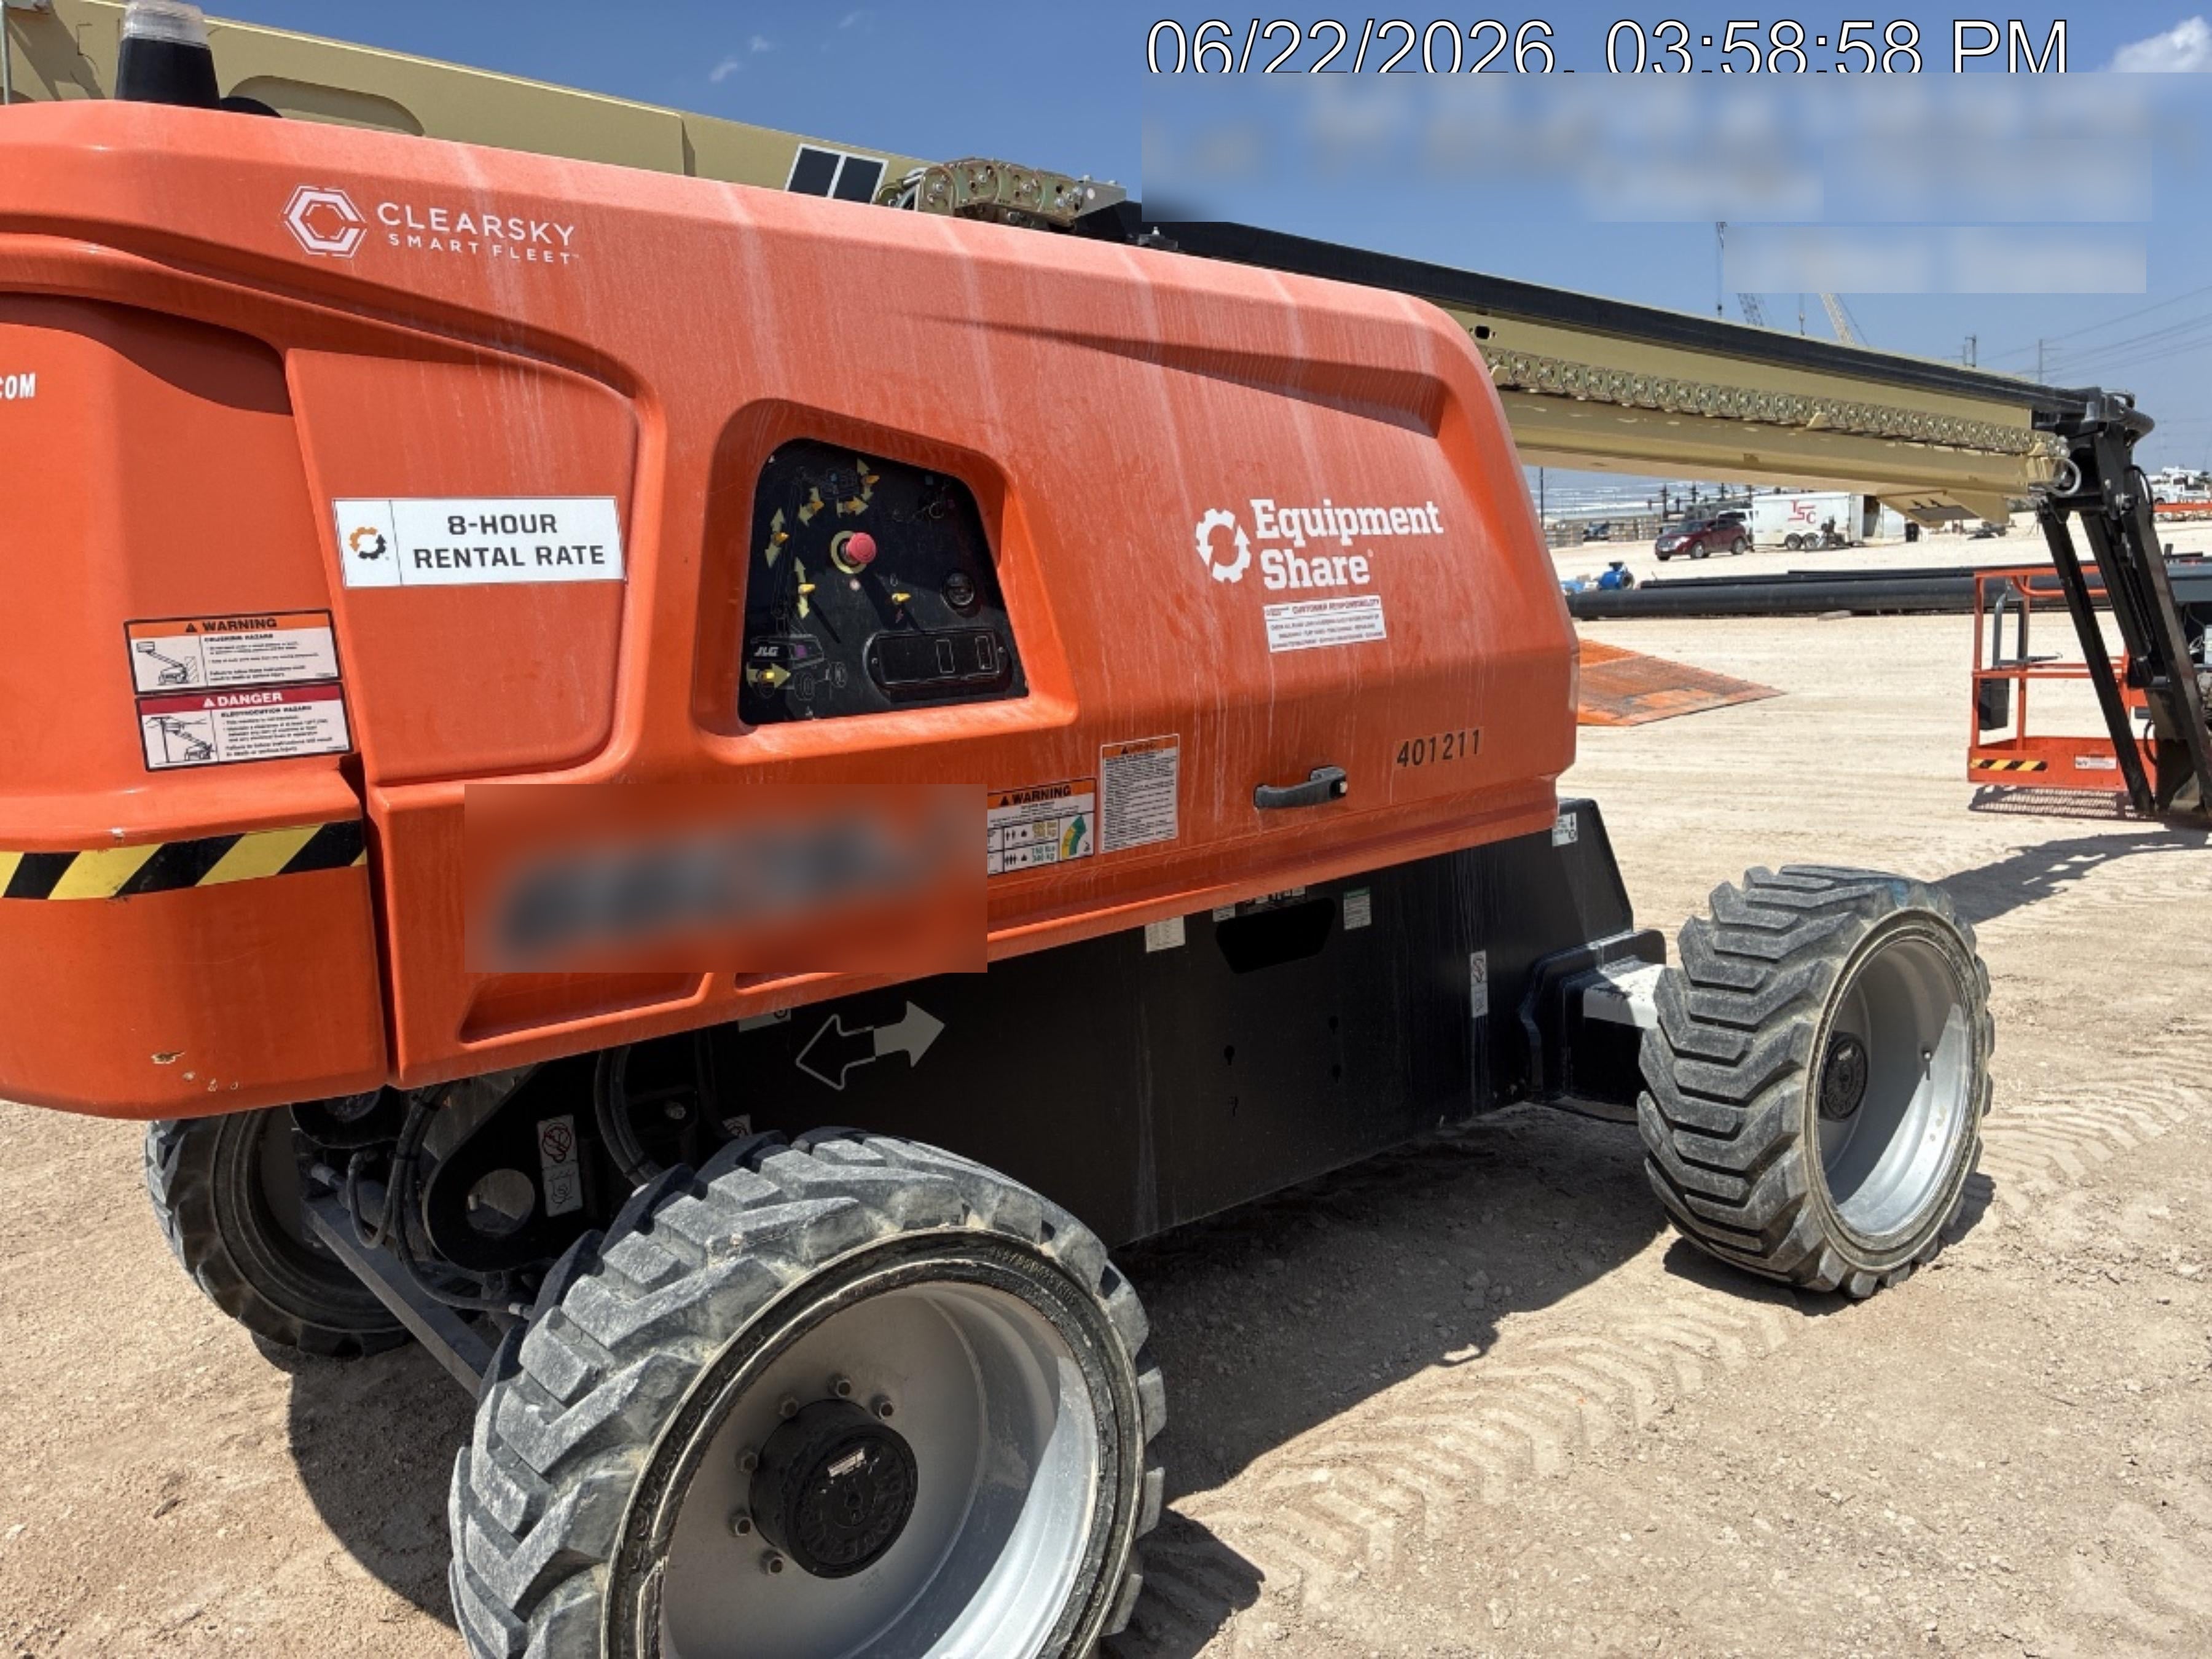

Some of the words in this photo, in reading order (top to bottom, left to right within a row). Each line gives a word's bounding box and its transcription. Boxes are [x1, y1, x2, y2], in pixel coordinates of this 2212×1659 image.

[377, 202, 575, 245] CLEARSKY
[388, 233, 479, 254] SMART
[447, 514, 557, 535] 8-HOUR
[1250, 498, 1444, 547] Equipment
[413, 546, 525, 568] RENTAL
[535, 545, 605, 566] RATE
[1260, 549, 1370, 590] Share
[203, 619, 277, 632] WARNING
[218, 692, 283, 706] DANGER
[1397, 729, 1479, 767] 401211
[1013, 785, 1072, 804] WARNING
